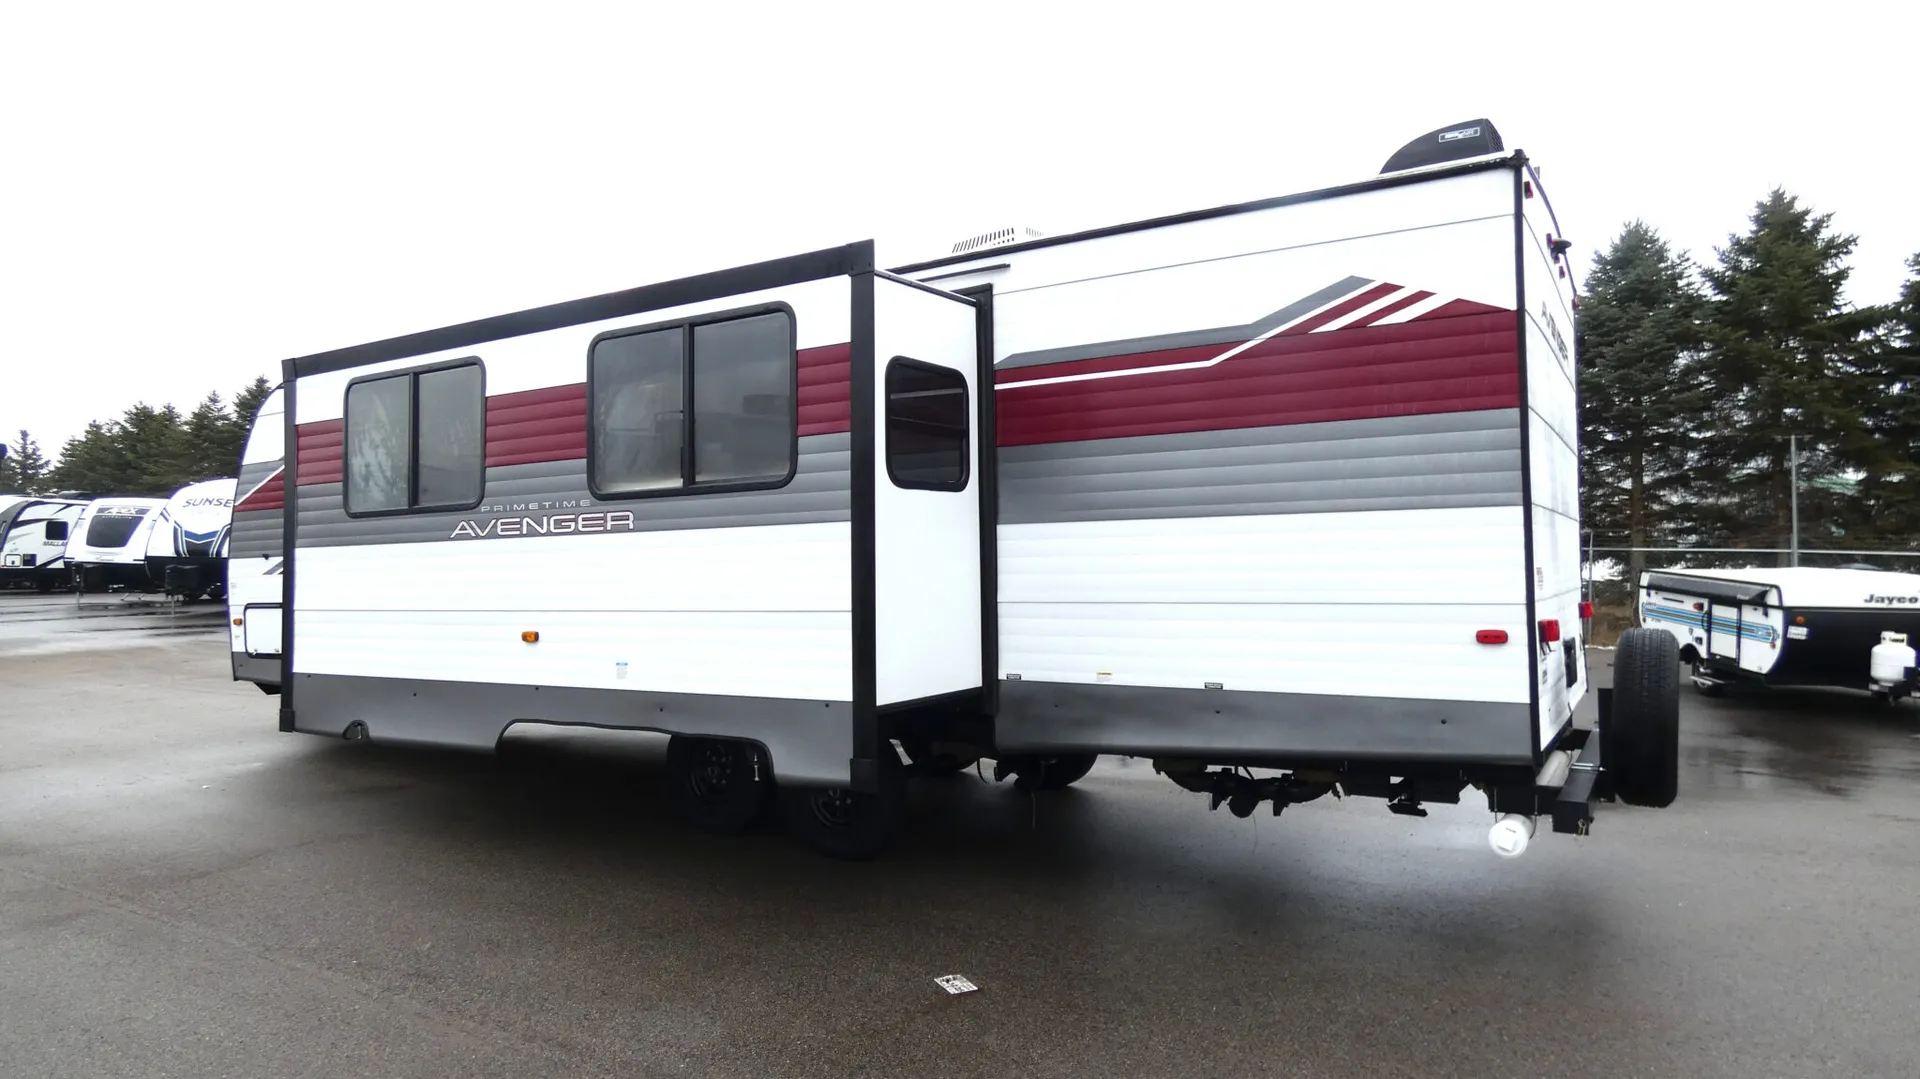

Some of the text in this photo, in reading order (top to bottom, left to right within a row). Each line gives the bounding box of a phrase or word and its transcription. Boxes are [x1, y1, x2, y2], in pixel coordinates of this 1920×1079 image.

[182, 497, 234, 508] SUNSE
[481, 499, 591, 512] PRIMETIME
[450, 511, 634, 538] AVENGER
[1863, 593, 1919, 607] Jayco
